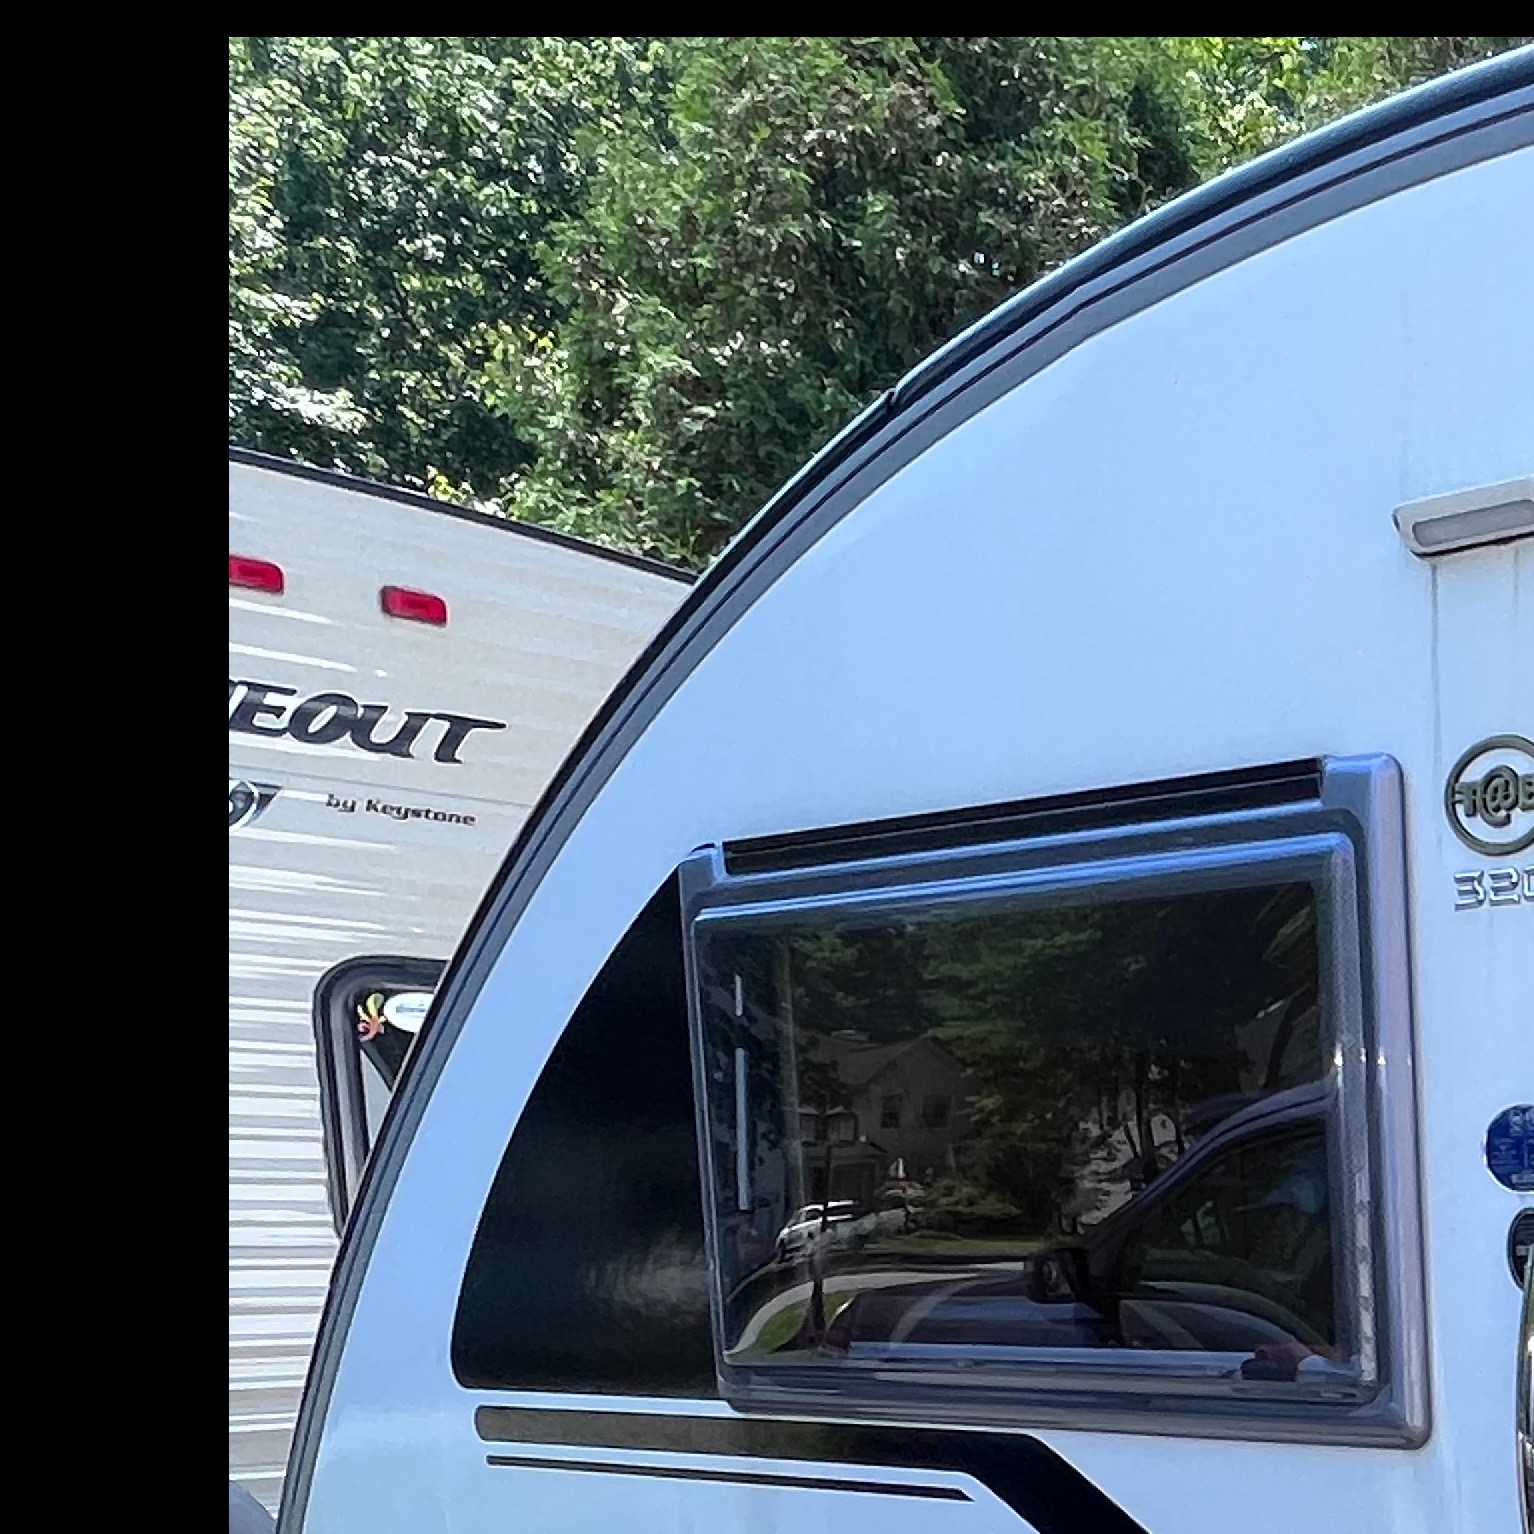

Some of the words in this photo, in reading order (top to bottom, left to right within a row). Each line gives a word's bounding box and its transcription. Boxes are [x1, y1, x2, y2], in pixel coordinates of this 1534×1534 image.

[229, 679, 507, 763] EOUT
[325, 793, 356, 813] by
[365, 798, 476, 826] Keystone
